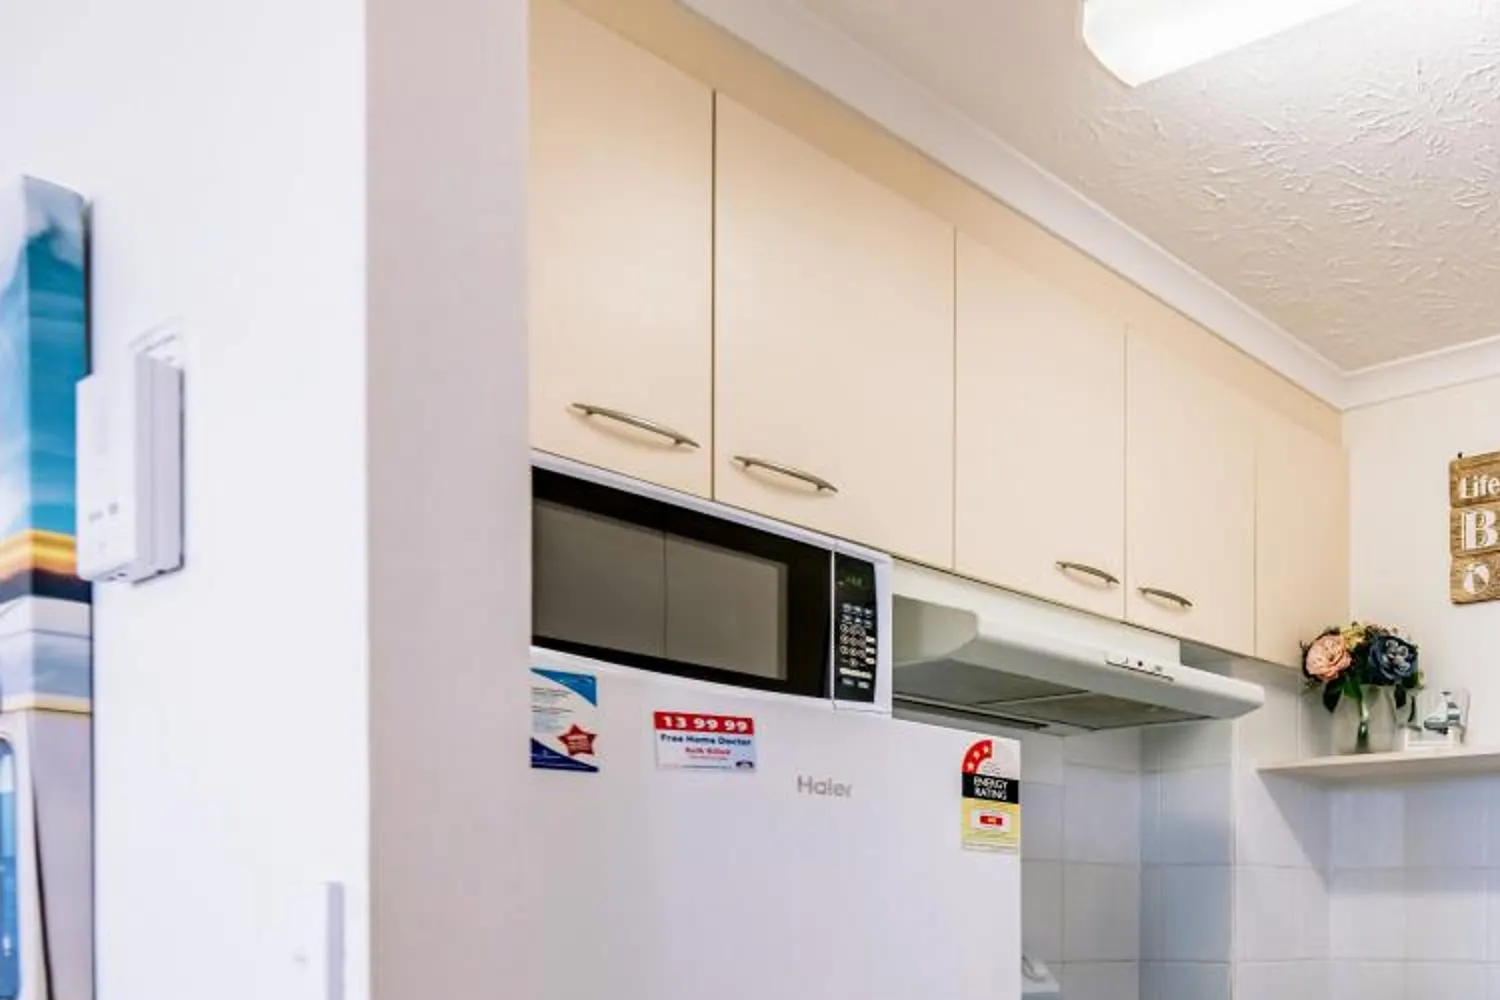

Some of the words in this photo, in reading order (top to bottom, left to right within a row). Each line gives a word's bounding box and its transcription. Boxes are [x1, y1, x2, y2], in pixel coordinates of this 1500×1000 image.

[1459, 473, 1500, 500] Life
[662, 715, 687, 728] 13
[693, 717, 719, 730] 99
[724, 719, 748, 733] 99
[661, 733, 684, 742] Free
[686, 735, 715, 744] Home
[717, 736, 751, 746] Doctor
[797, 774, 853, 798] Haier
[974, 775, 1008, 790] ENERGY
[975, 787, 1007, 801] RATING
